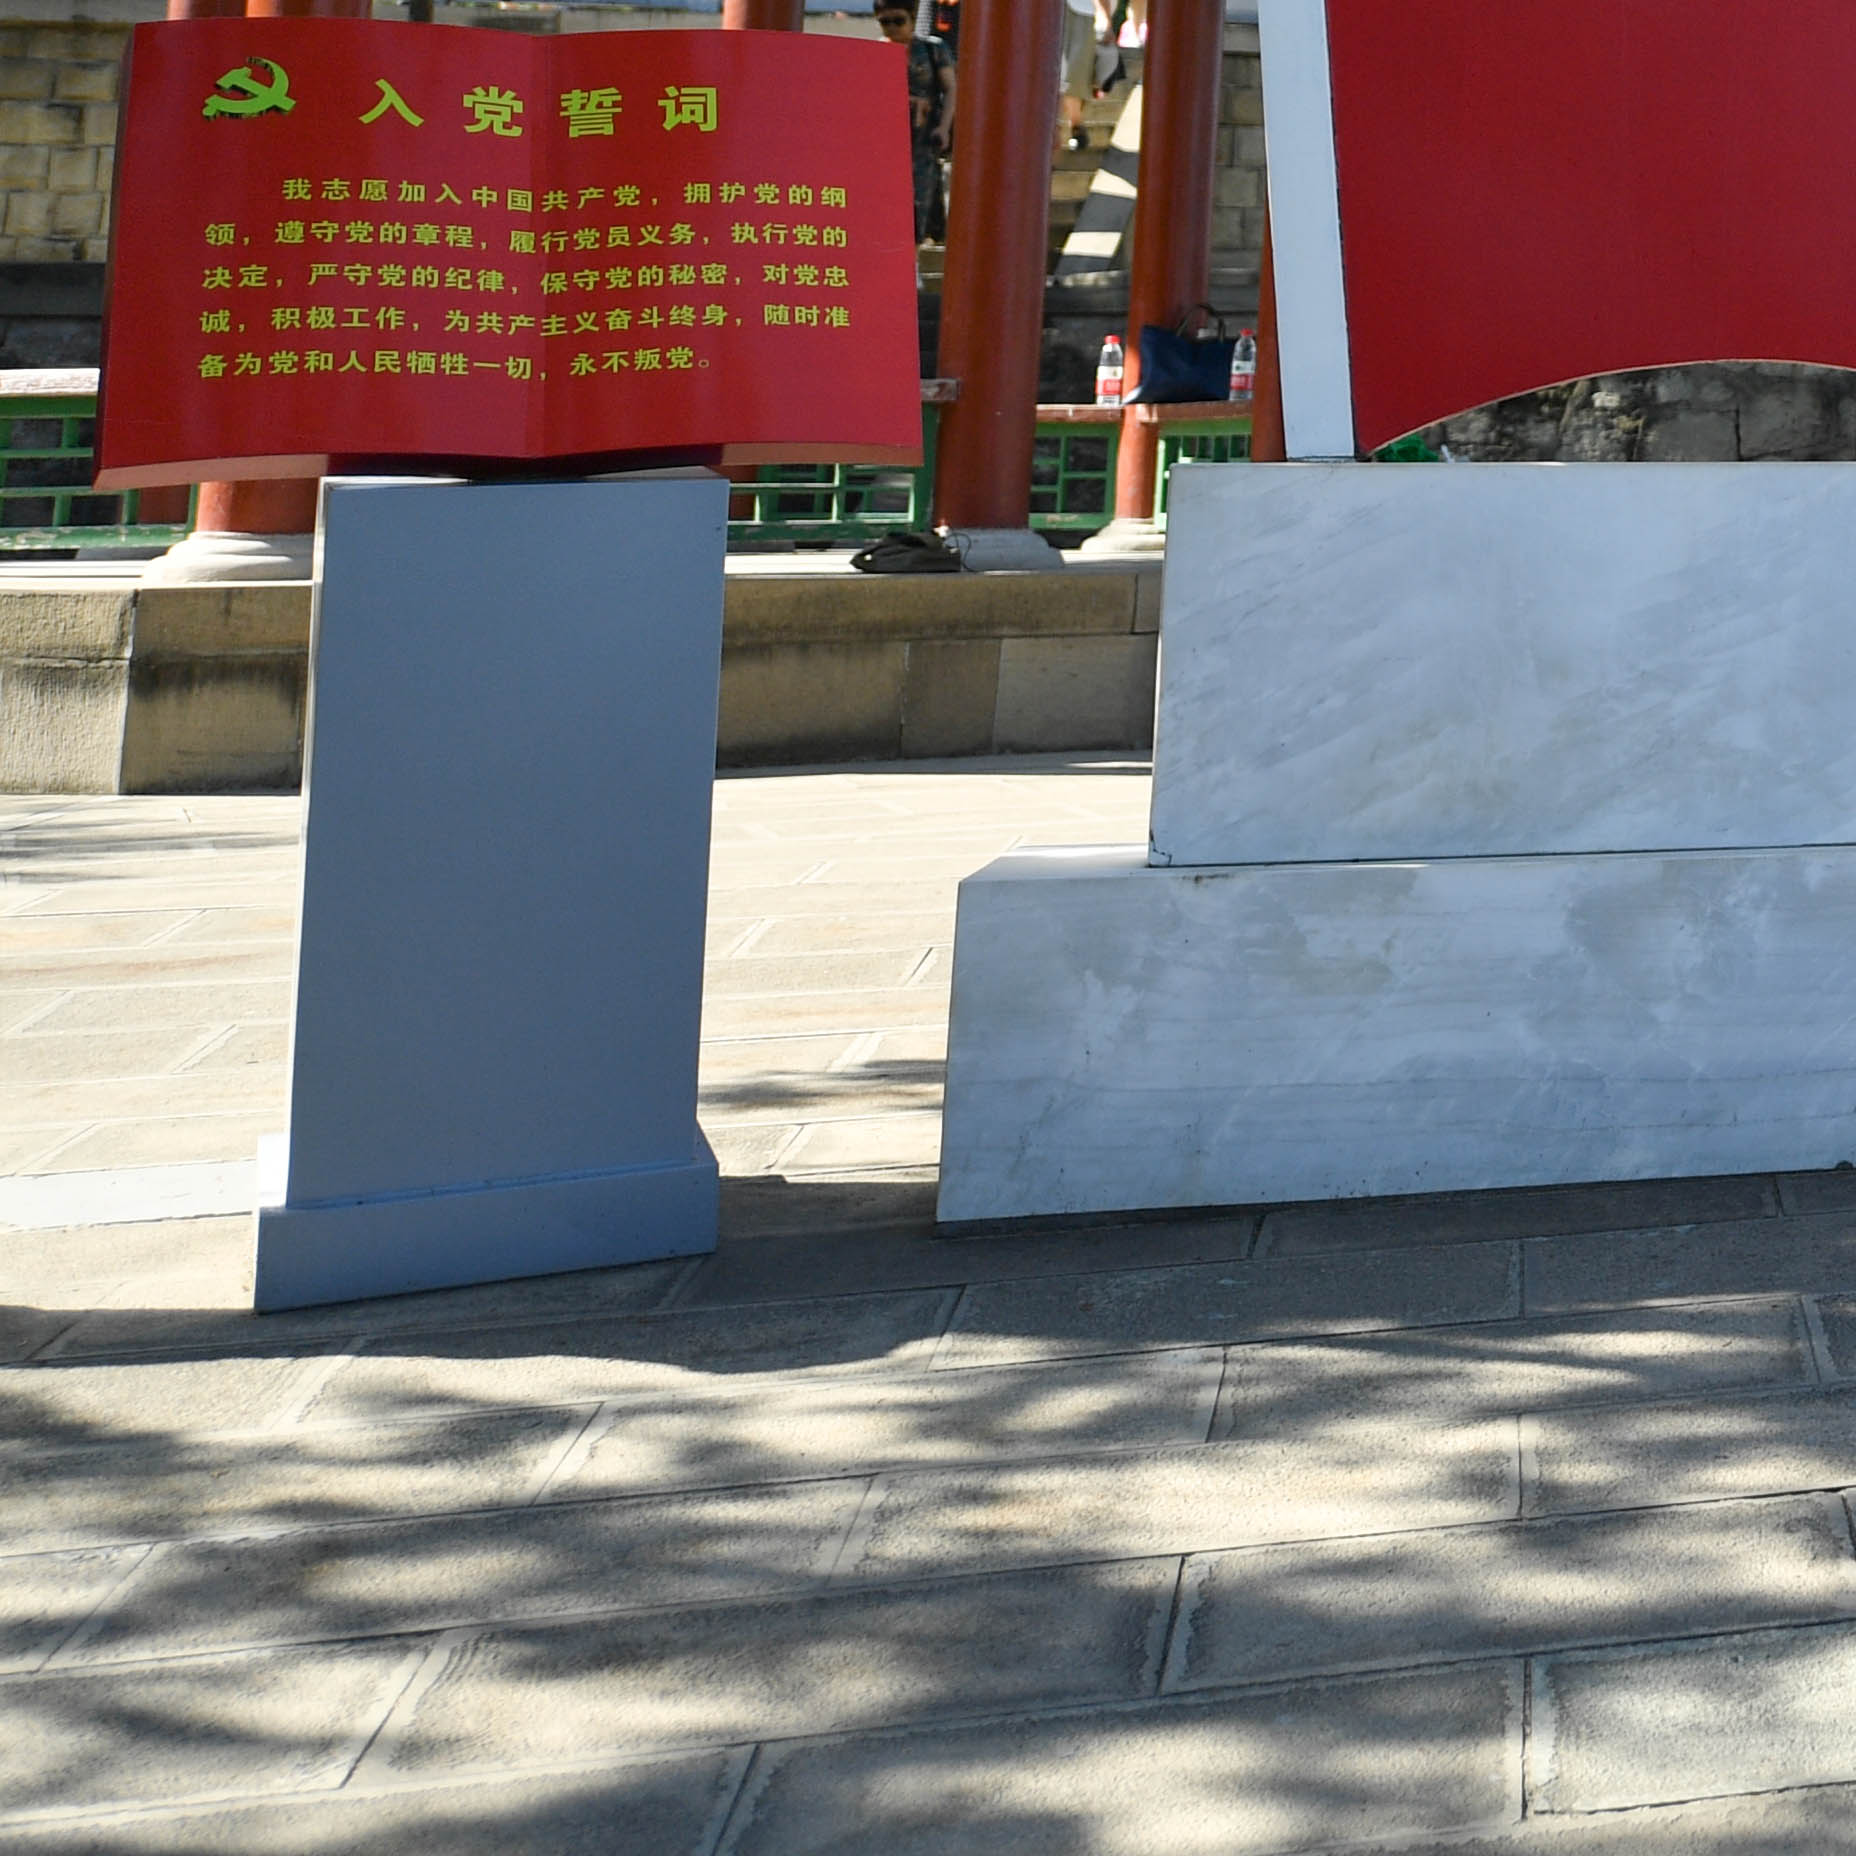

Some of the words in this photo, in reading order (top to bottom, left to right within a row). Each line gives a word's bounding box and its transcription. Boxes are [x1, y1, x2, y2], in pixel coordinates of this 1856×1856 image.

[358, 78, 719, 138] 入党誓词
[282, 178, 847, 213] 我志愿加入中国共产党，拥护党的纲
[205, 220, 848, 255] 领，遵守党的章程，履行党员义务，执行党的
[202, 262, 850, 295] 决定，严守党的纪律，保守党的秘密，对党忠
[199, 303, 850, 337] 诚，积极工作，为共产主义奋斗终身，随时准
[198, 346, 710, 380] 备为党和人民牺牲一切，永不叛党。
